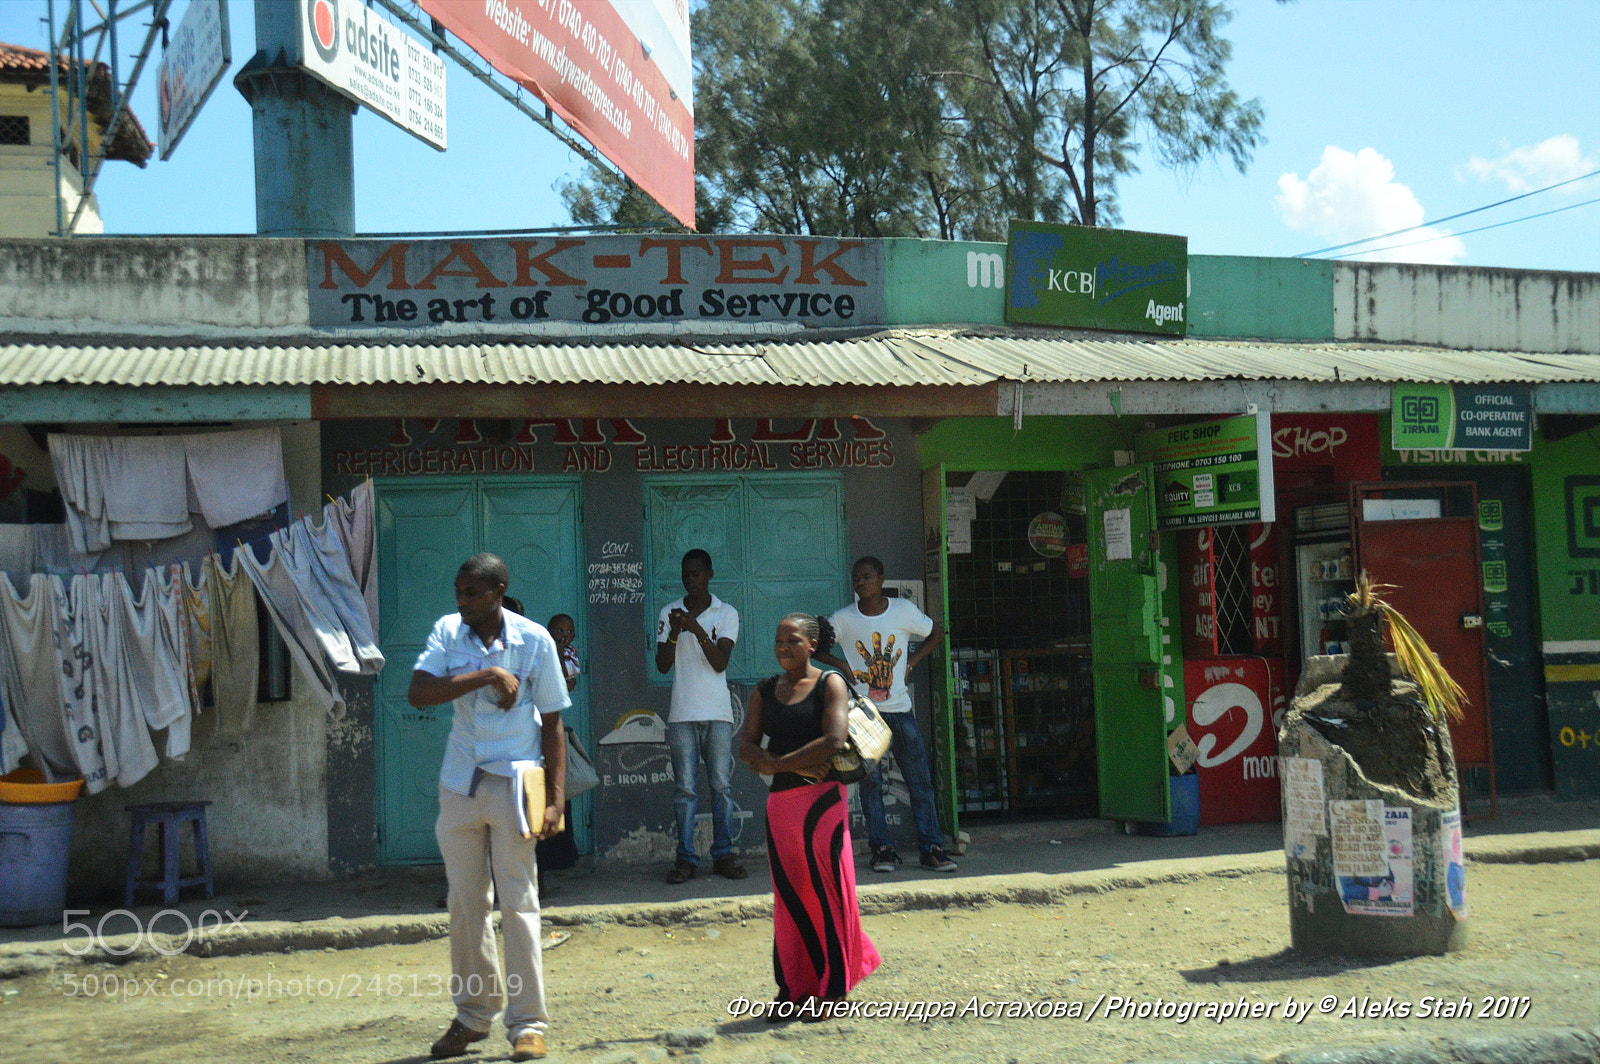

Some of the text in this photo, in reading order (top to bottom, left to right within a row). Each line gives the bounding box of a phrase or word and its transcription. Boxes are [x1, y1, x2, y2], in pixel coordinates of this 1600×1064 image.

[346, 6, 400, 83] adsite
[407, 45, 420, 63] 0727
[423, 55, 433, 71] 531
[485, 0, 631, 139] Website: www.skywardexpress.co.ke
[559, 1, 581, 39] 0740
[582, 20, 597, 54] 410
[599, 34, 611, 71] 702
[615, 58, 632, 95] 0740
[632, 78, 643, 109] 410
[644, 90, 655, 122] 703
[658, 110, 671, 141] 0740
[341, 288, 856, 324] The art of good Service
[1145, 299, 1184, 327] Agent
[1475, 395, 1514, 406] OFFICIAL
[1460, 410, 1526, 422] CO-OPERATIVE
[1167, 424, 1221, 444] FEIC SHOP
[1401, 424, 1439, 434] JIRANI
[1465, 427, 1523, 437] BANK AGENT
[1272, 427, 1348, 458] SHOP
[333, 441, 896, 475] REFRIGERATION AND ELECTRICAL SERVICES
[1195, 457, 1212, 467] 0703
[1214, 456, 1227, 465] 150
[1229, 453, 1242, 462] 100
[1164, 491, 1190, 502] EQUITY
[1228, 483, 1241, 492] KCB
[618, 773, 647, 785] IRON
[650, 771, 675, 783] BOX
